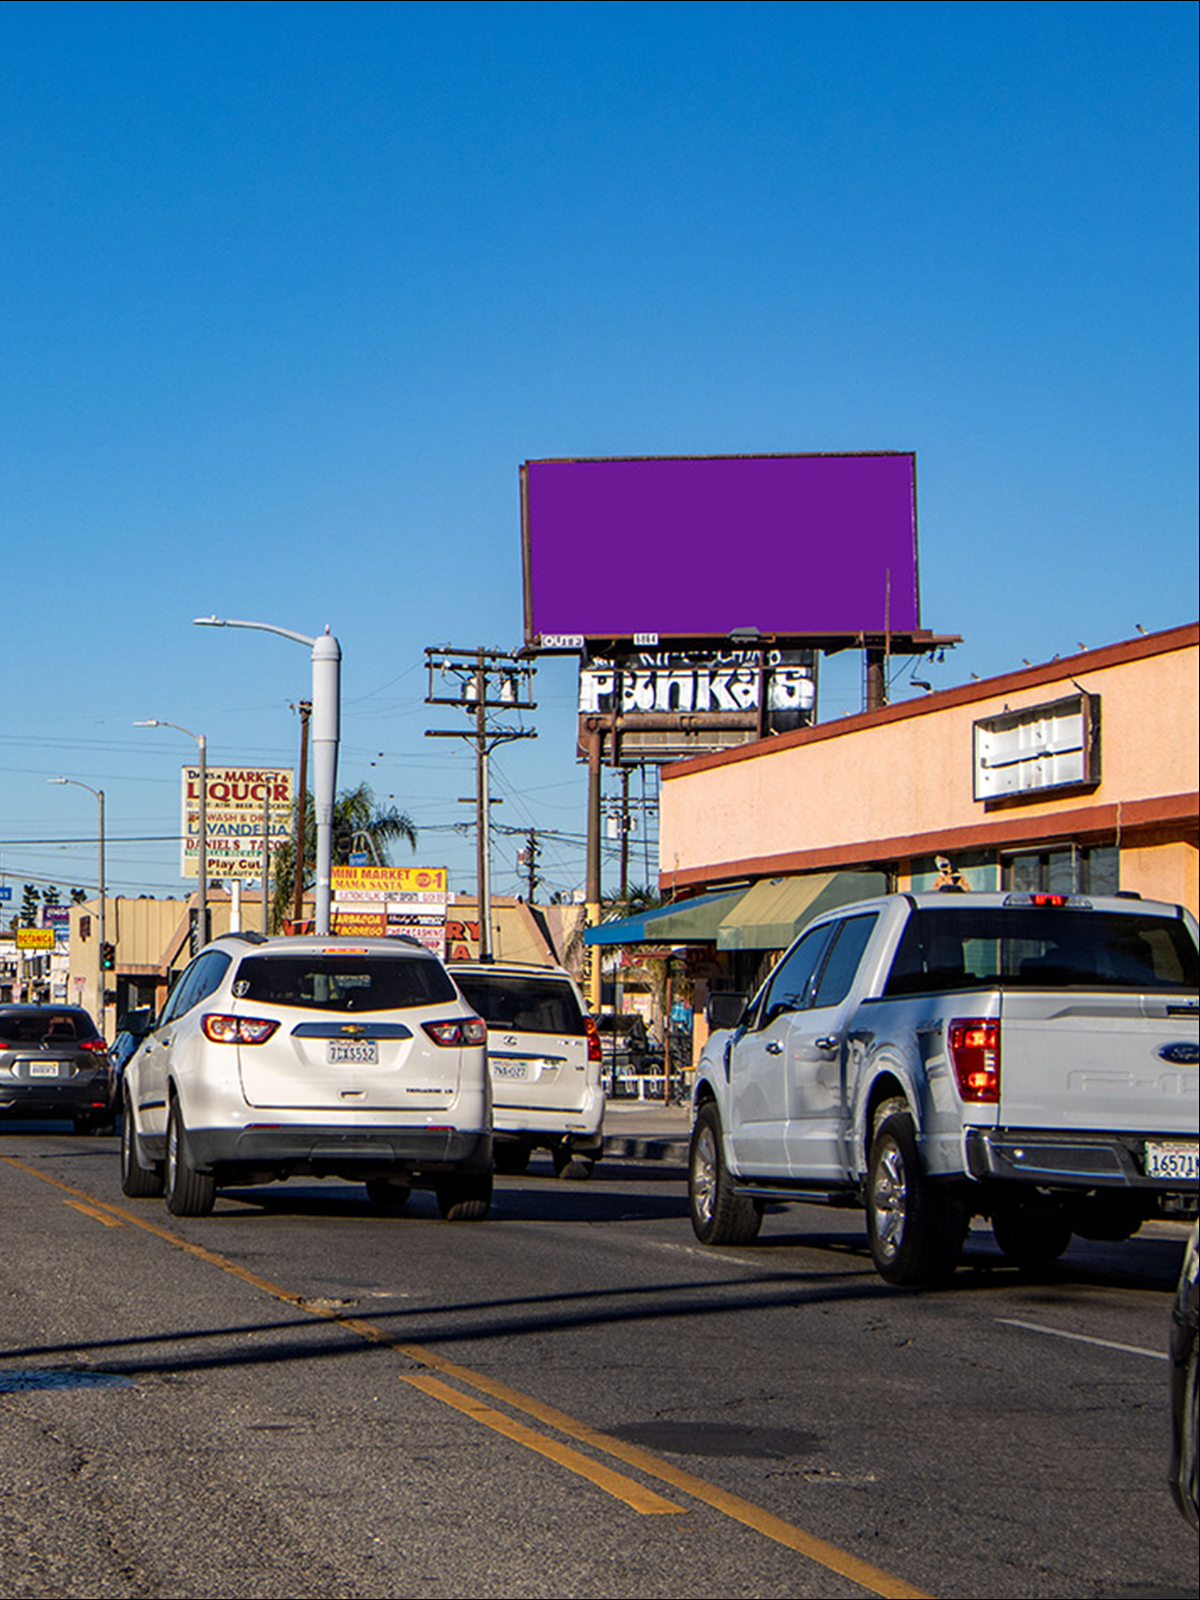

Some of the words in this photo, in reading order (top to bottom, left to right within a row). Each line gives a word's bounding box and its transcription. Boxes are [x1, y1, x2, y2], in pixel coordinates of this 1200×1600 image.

[188, 782, 289, 802] LQUOR
[208, 859, 234, 870] Play
[360, 869, 410, 880] MARKET
